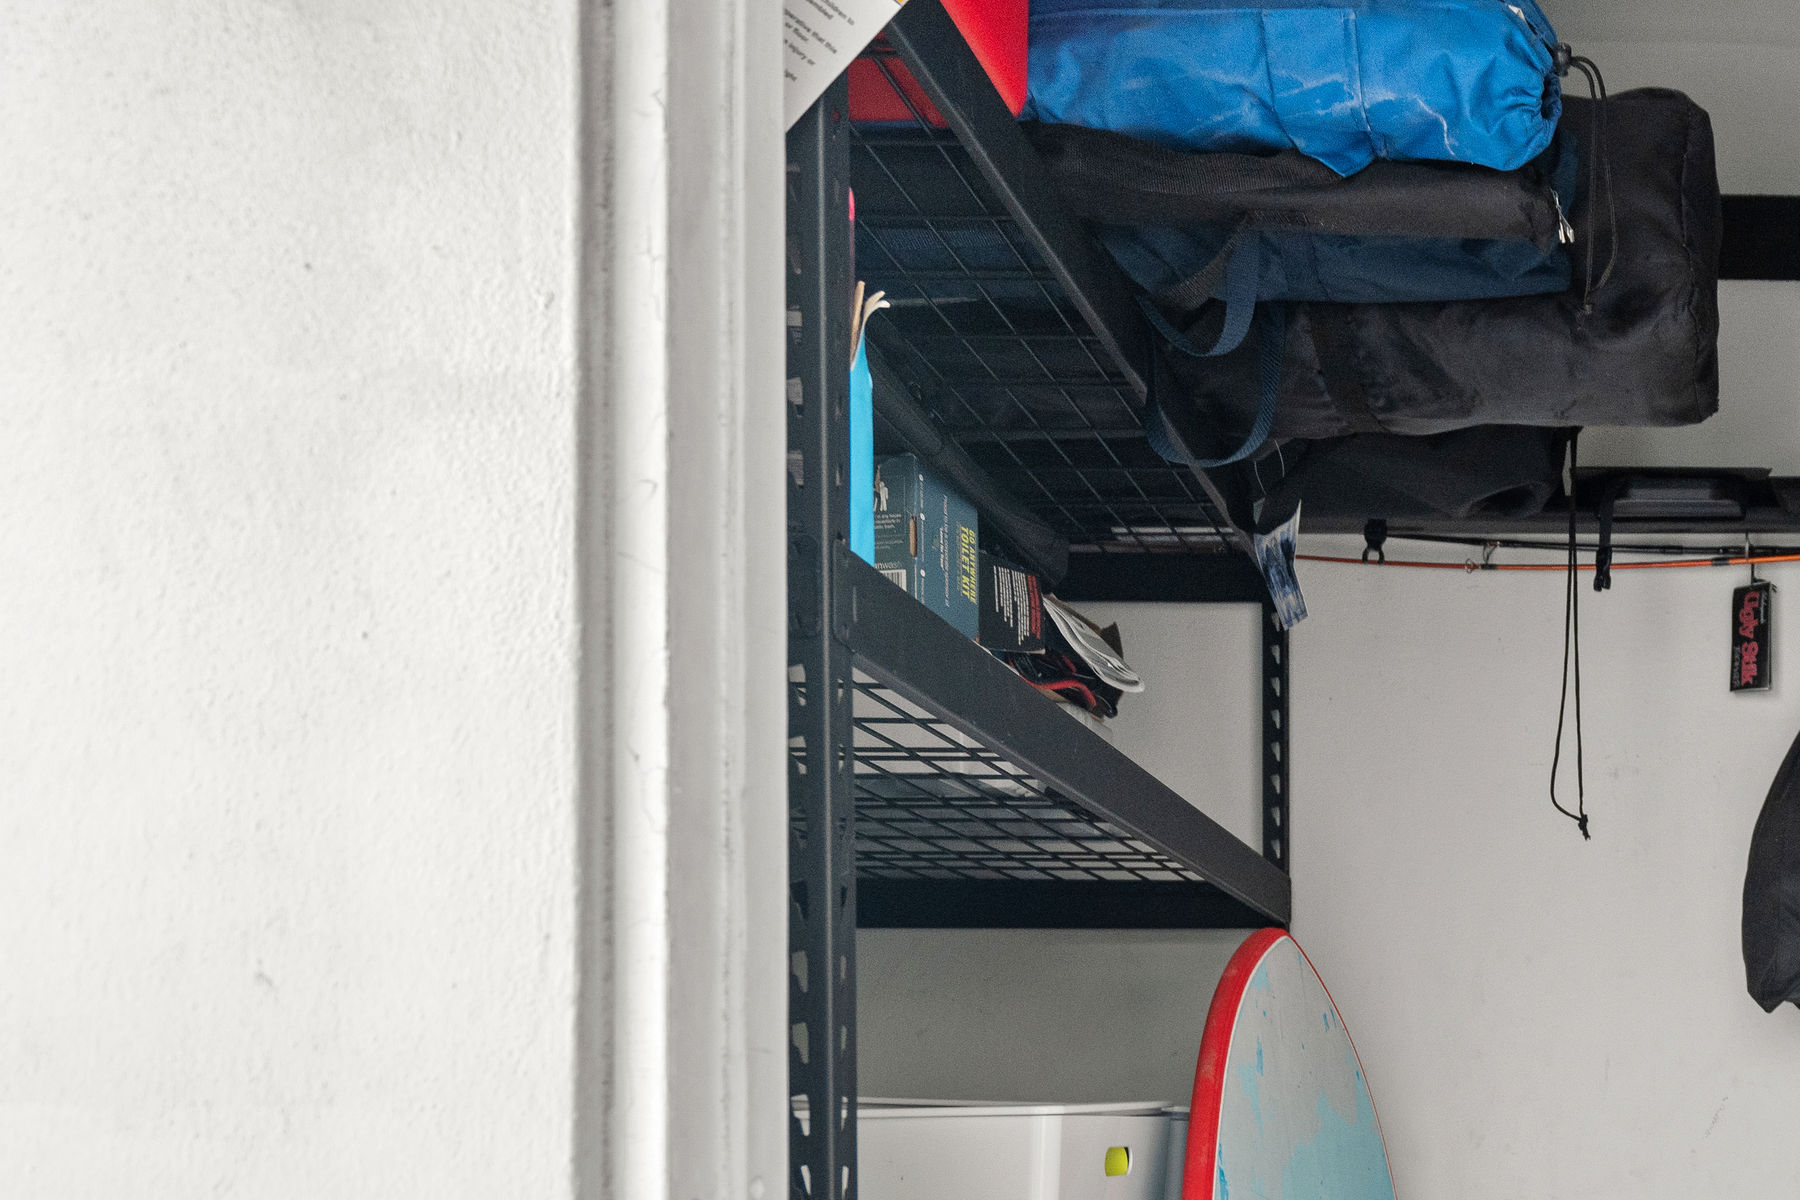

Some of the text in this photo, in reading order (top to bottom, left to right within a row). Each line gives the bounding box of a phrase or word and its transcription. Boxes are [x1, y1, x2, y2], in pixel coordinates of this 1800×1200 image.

[961, 526, 970, 599] TOILET KIT
[968, 529, 976, 545] GO
[1739, 591, 1760, 686] Ugly Stik
